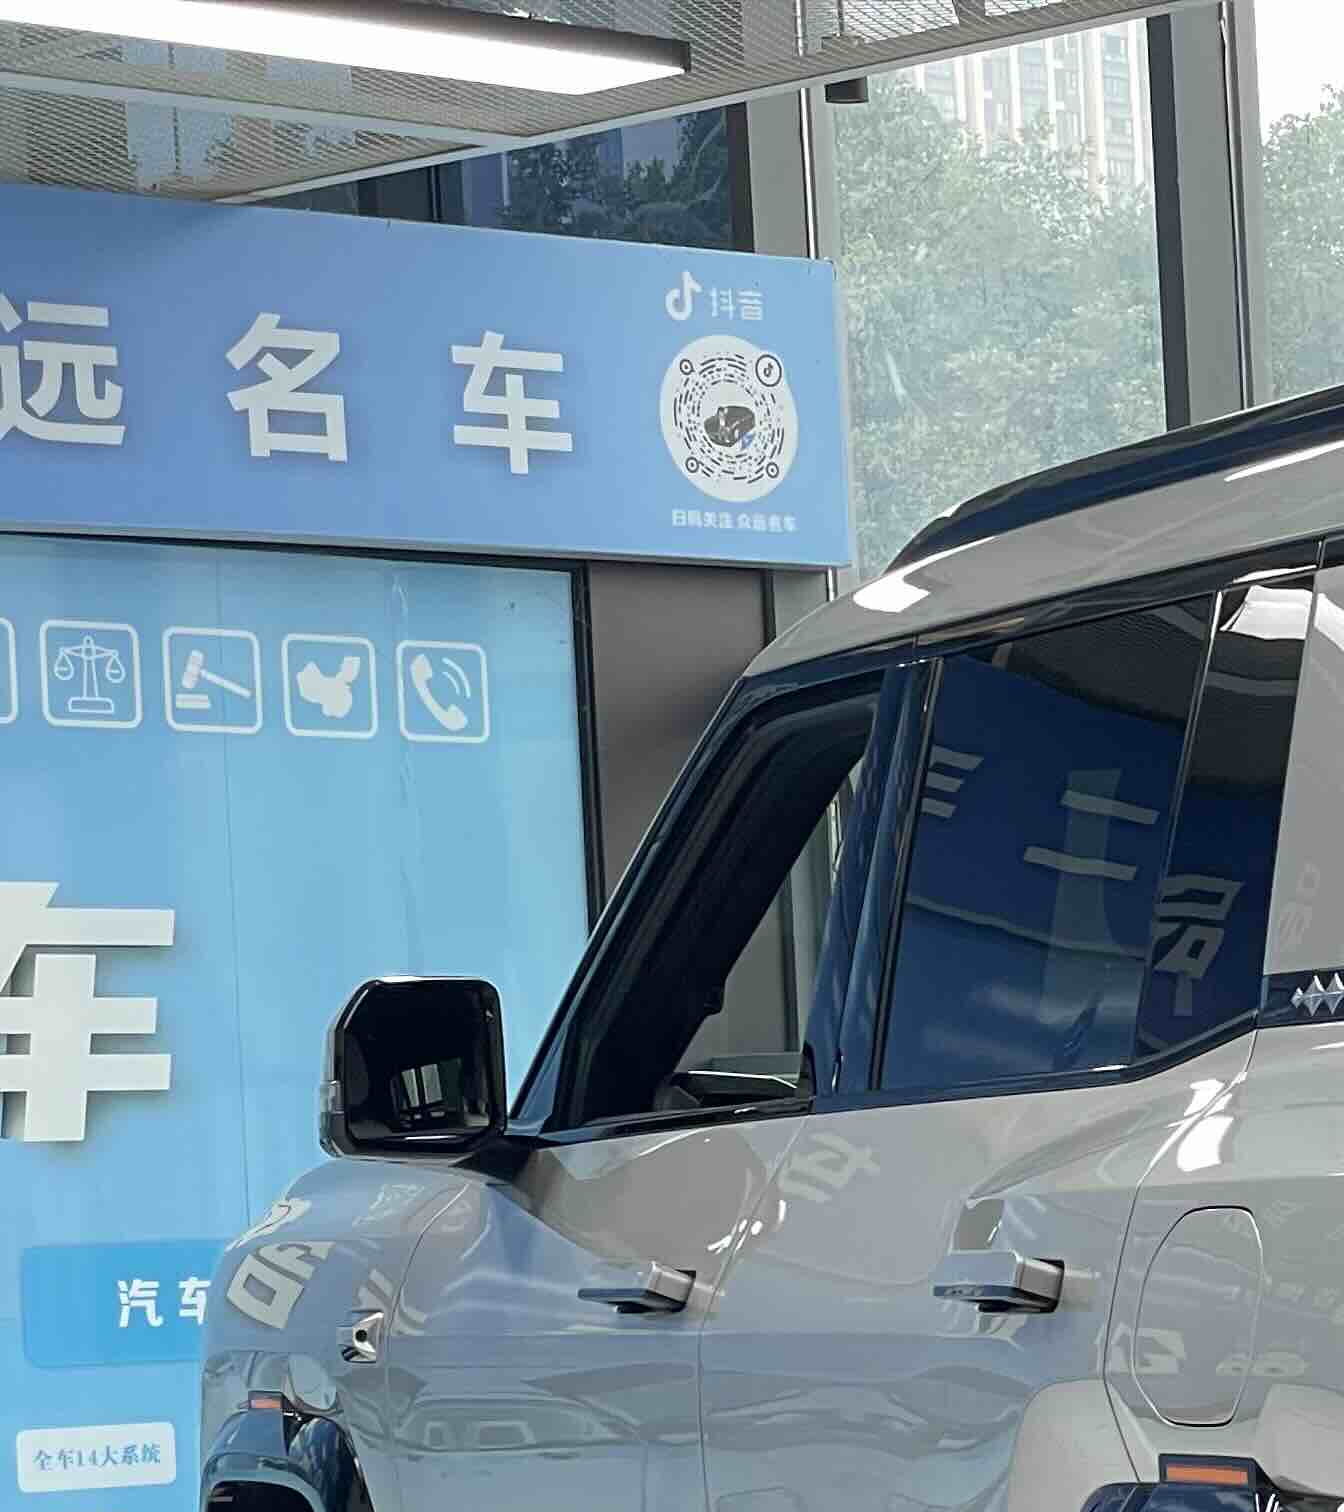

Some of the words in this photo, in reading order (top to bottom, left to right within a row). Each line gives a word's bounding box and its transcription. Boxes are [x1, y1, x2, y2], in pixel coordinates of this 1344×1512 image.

[709, 287, 764, 321] 抖音
[117, 1277, 211, 1329] 汽车
[34, 1443, 161, 1470] 全车14大系统
